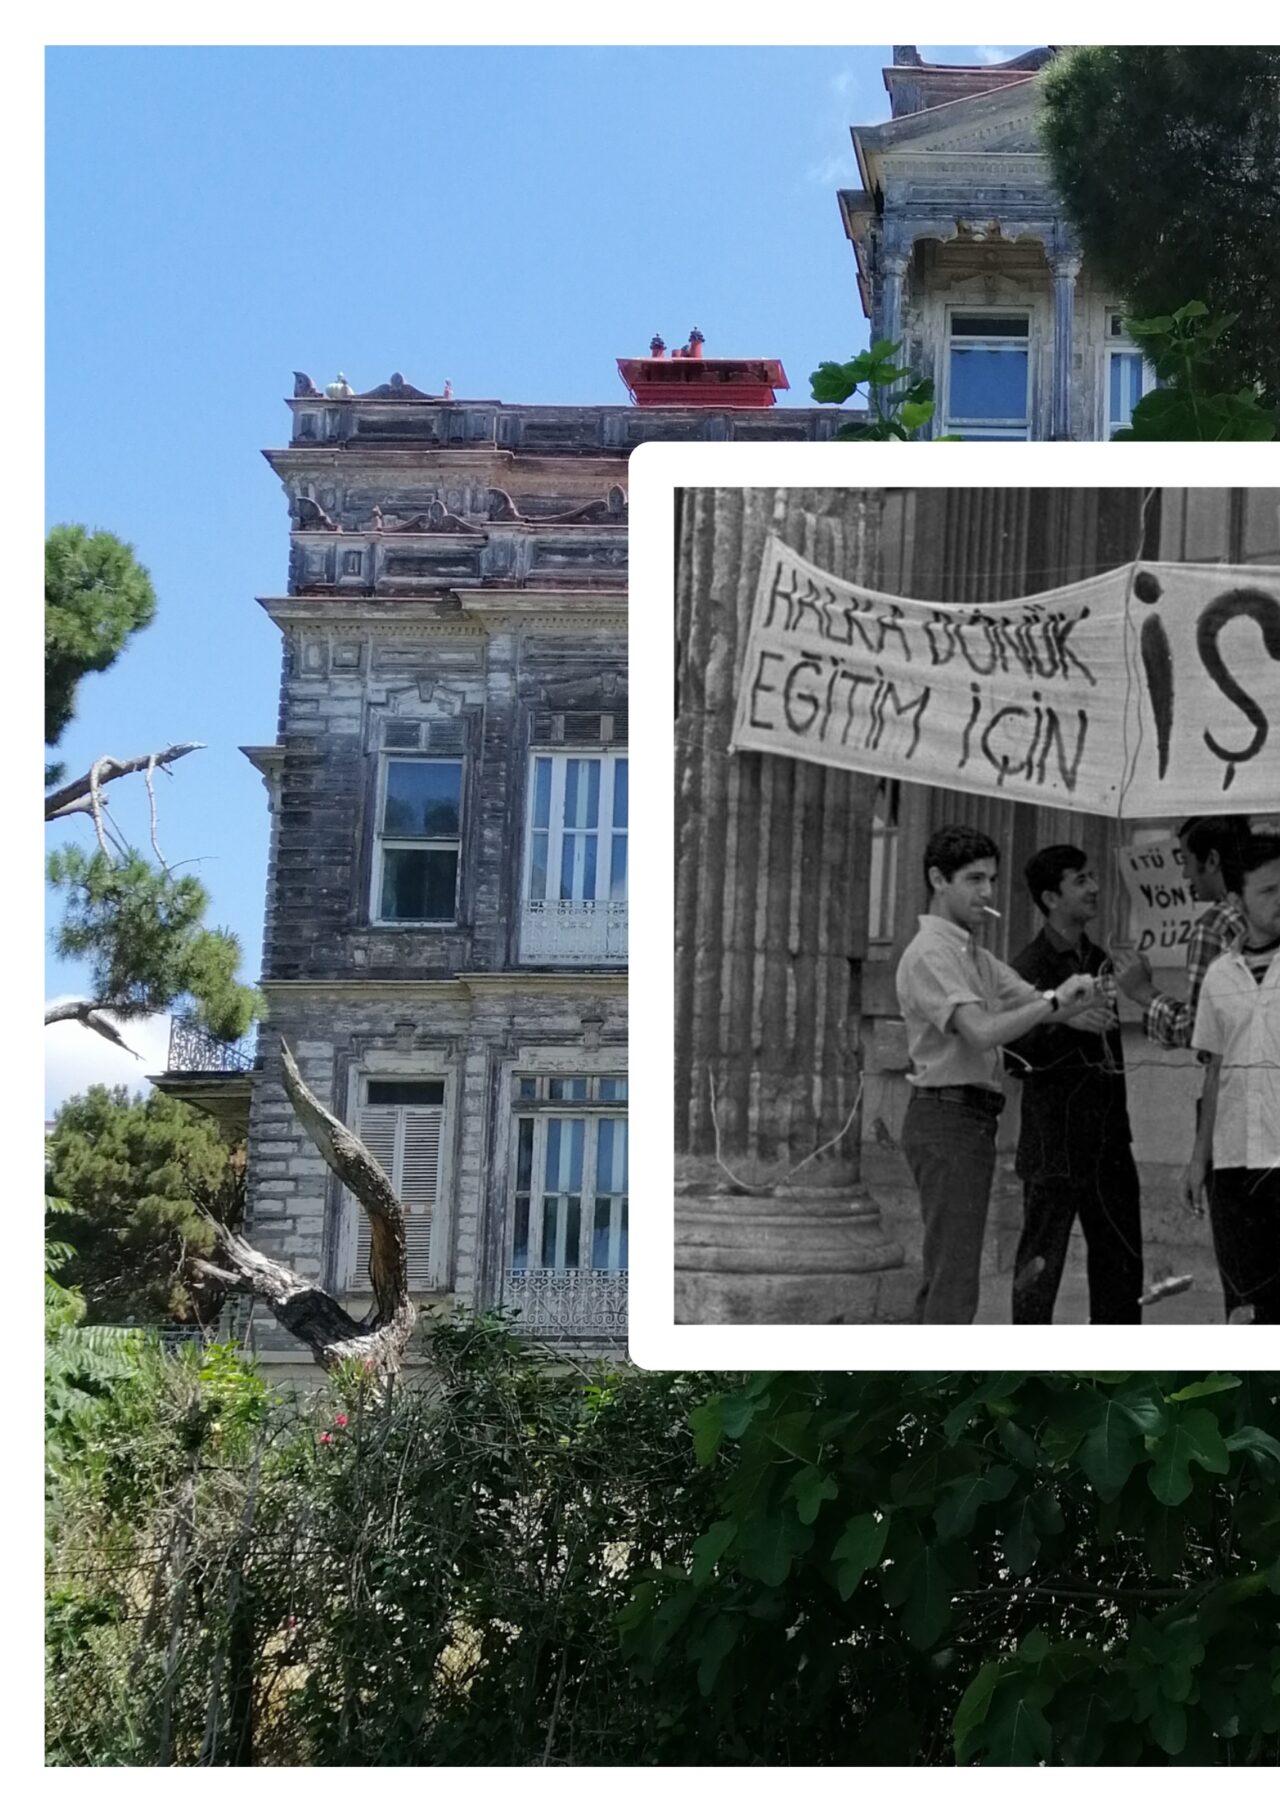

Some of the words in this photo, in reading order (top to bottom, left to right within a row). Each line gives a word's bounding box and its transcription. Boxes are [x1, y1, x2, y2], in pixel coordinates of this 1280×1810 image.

[763, 561, 912, 662] HALKA
[923, 604, 1097, 687] DÖNÜK
[749, 650, 931, 759] EĞİTİM
[958, 682, 1089, 792] İÇİN
[1138, 919, 1192, 951] DÜZ
[1139, 883, 1200, 909] YÖNE
